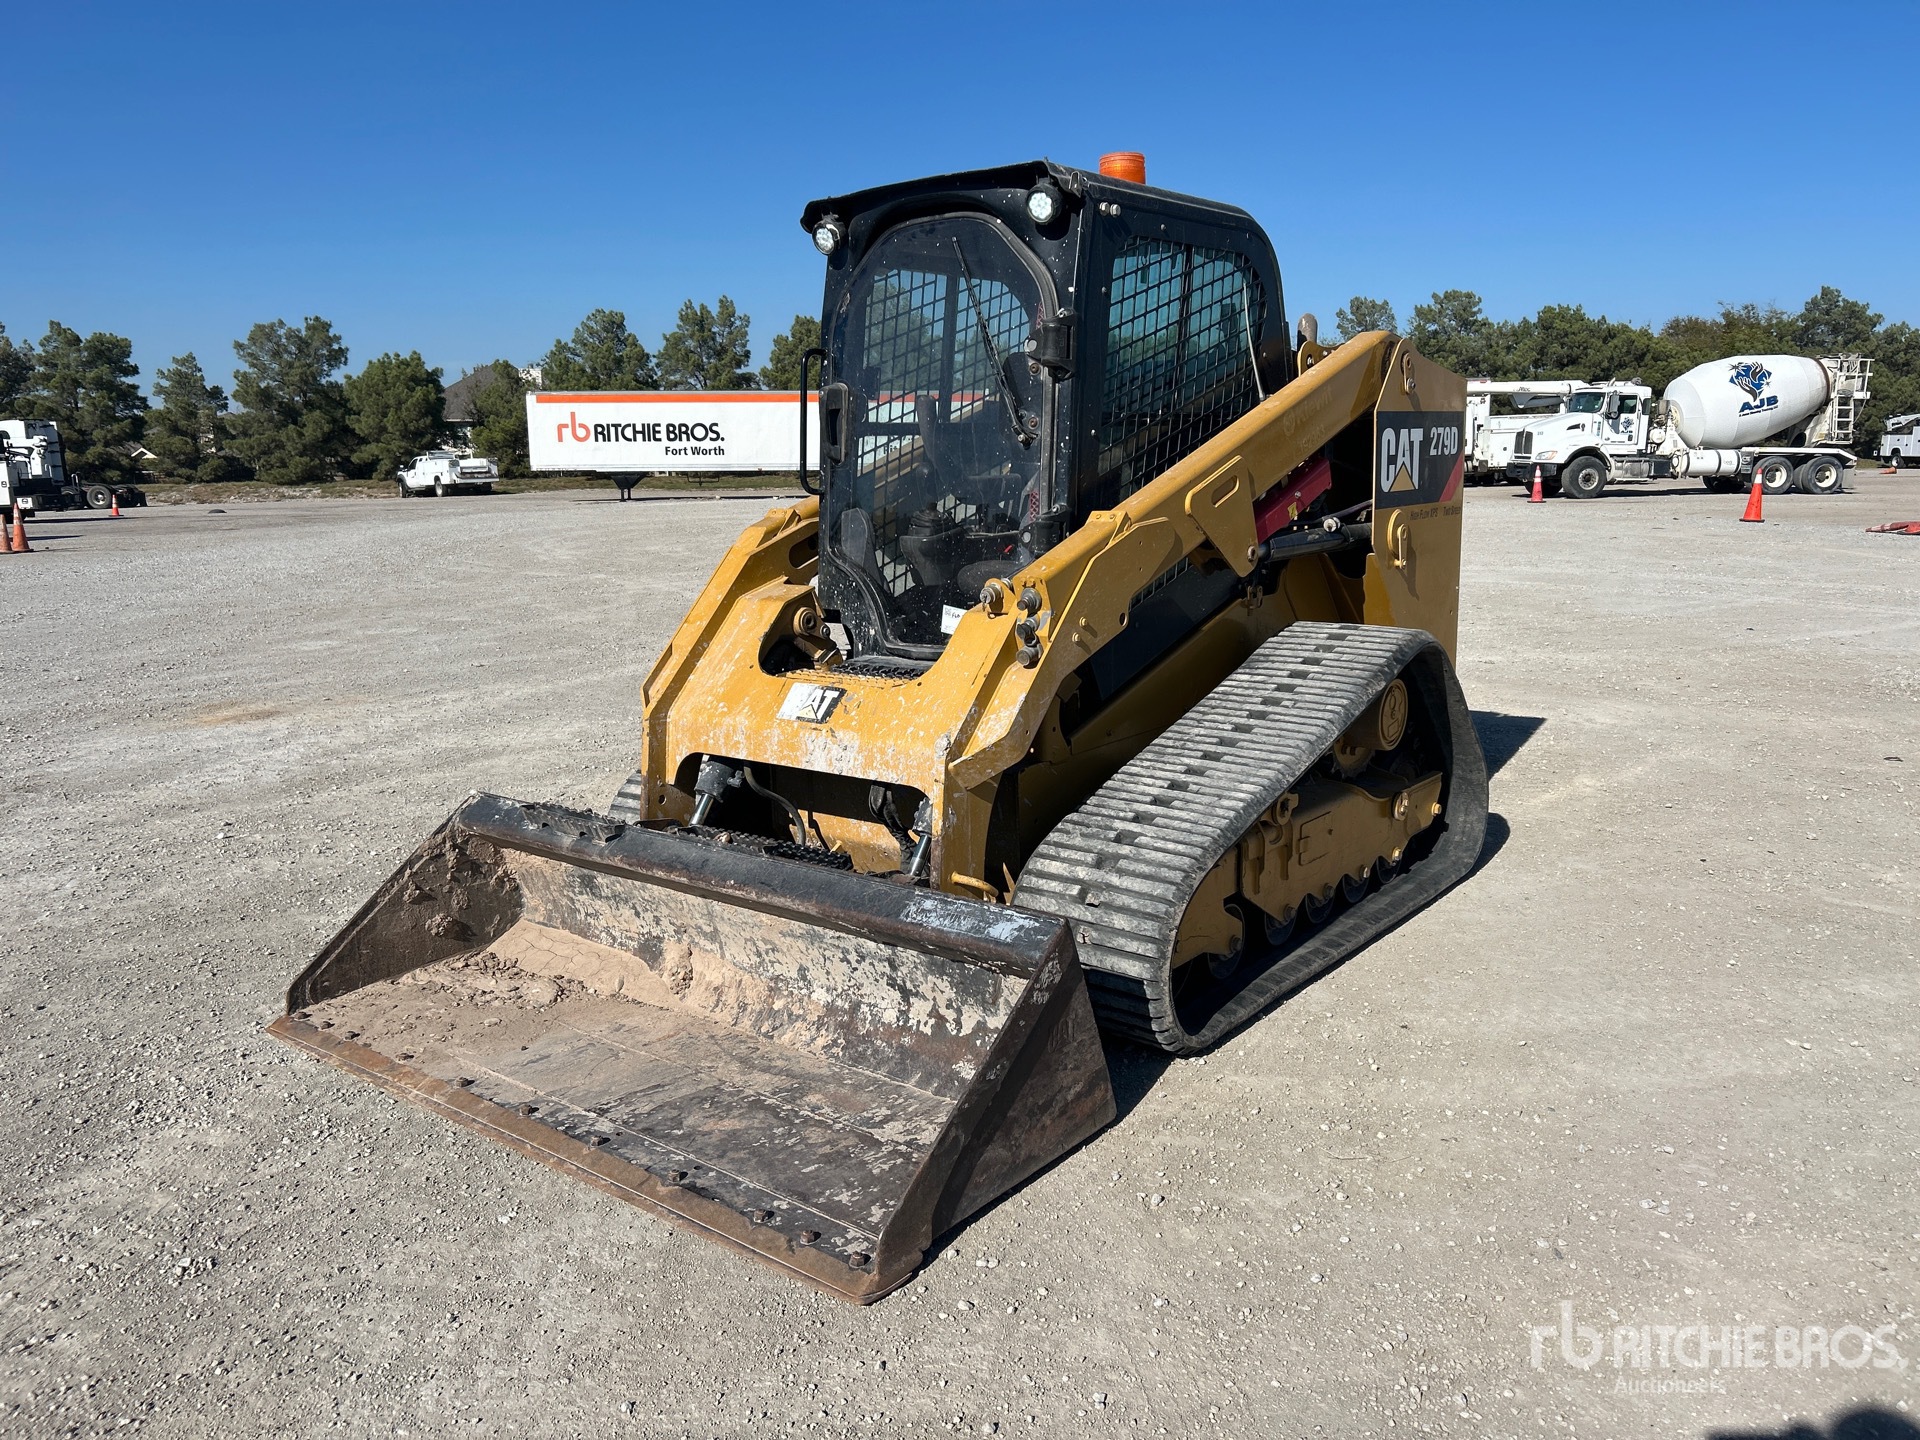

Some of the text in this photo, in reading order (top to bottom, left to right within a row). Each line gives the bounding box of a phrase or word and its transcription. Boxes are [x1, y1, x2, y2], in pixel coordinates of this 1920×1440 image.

[1739, 395, 1779, 413] AJB
[557, 412, 725, 442] rb RITCHIE BROS.
[665, 446, 725, 456] Fort Worth
[1380, 427, 1424, 493] CAT
[1429, 426, 1459, 456] 279D
